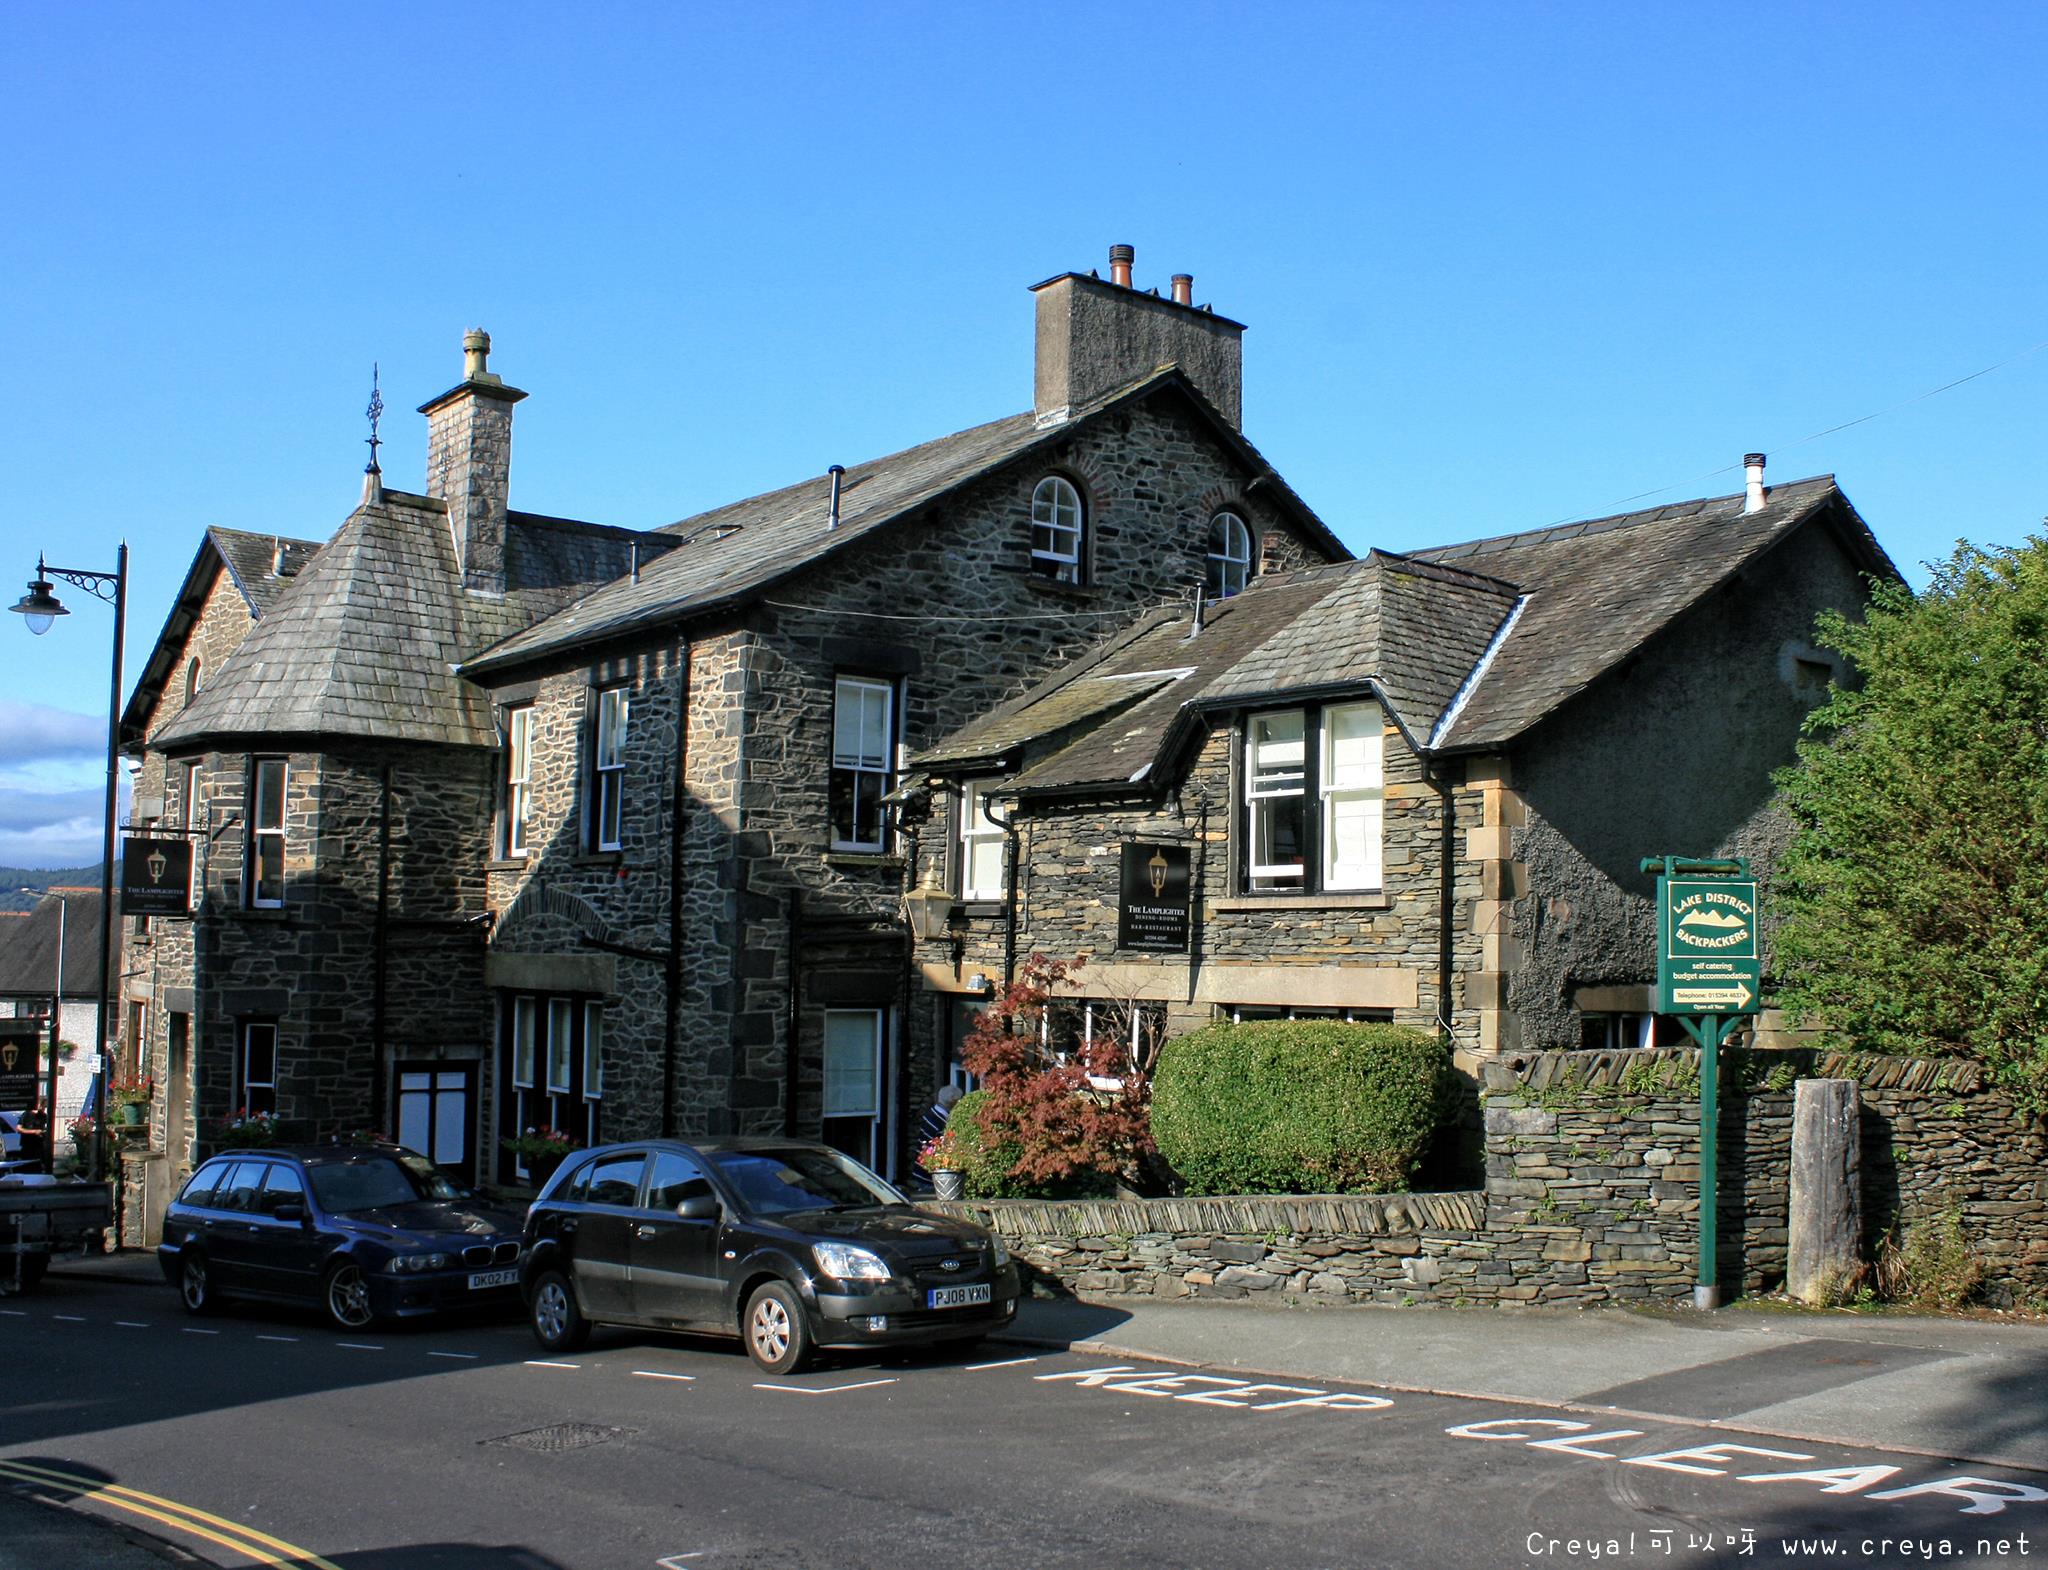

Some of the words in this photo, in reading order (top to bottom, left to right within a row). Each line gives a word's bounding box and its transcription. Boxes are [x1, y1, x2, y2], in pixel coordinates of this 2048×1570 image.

[1128, 905, 1141, 913] THE
[1142, 905, 1185, 916] LAMPLIGHTER
[1673, 894, 1702, 914] LAKE
[1706, 893, 1752, 916] DISTRICT
[1675, 928, 1749, 948] BACKPACKERS
[1692, 962, 1705, 970] self
[1706, 962, 1733, 971] catering
[1673, 972, 1698, 980] budget
[1699, 972, 1752, 980] accommodation
[474, 1274, 501, 1287] DK02
[503, 1271, 519, 1282] FY
[935, 1289, 966, 1306] PJ08
[968, 1286, 989, 1302] VXN
[1033, 1366, 1395, 1411] KEEP
[1445, 1418, 2048, 1515] CLEAR
